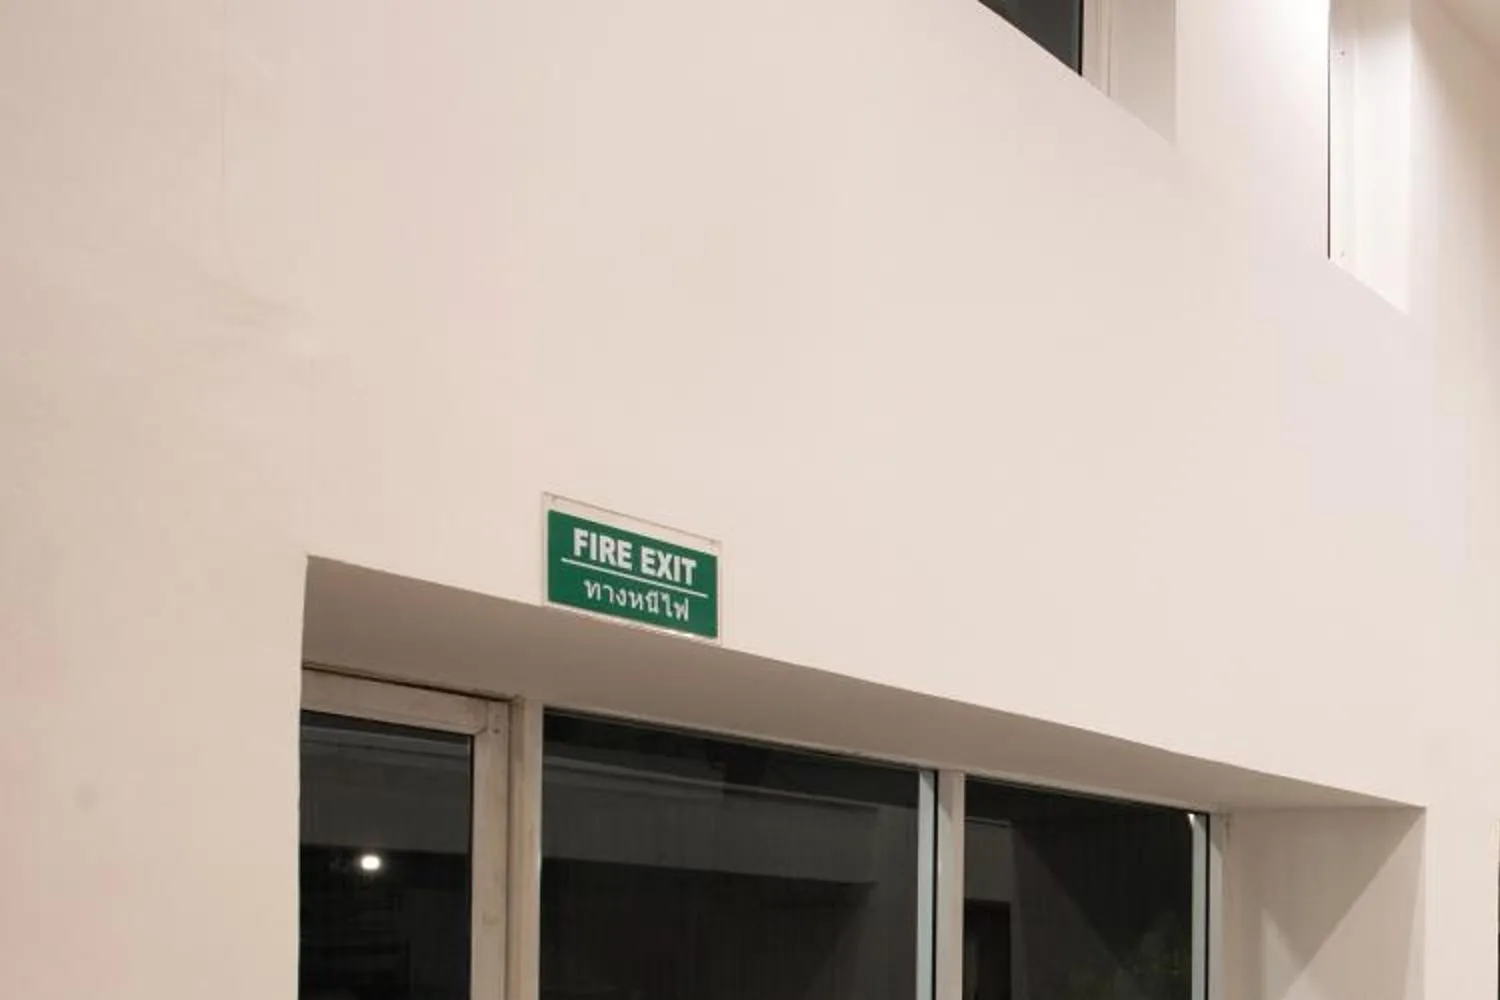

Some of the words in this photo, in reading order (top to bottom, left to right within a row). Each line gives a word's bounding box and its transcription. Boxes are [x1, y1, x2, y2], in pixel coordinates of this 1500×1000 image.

[573, 528, 633, 571] FIRE
[640, 546, 697, 586] EXIT
[583, 579, 690, 622] ทางหนีไฟ
